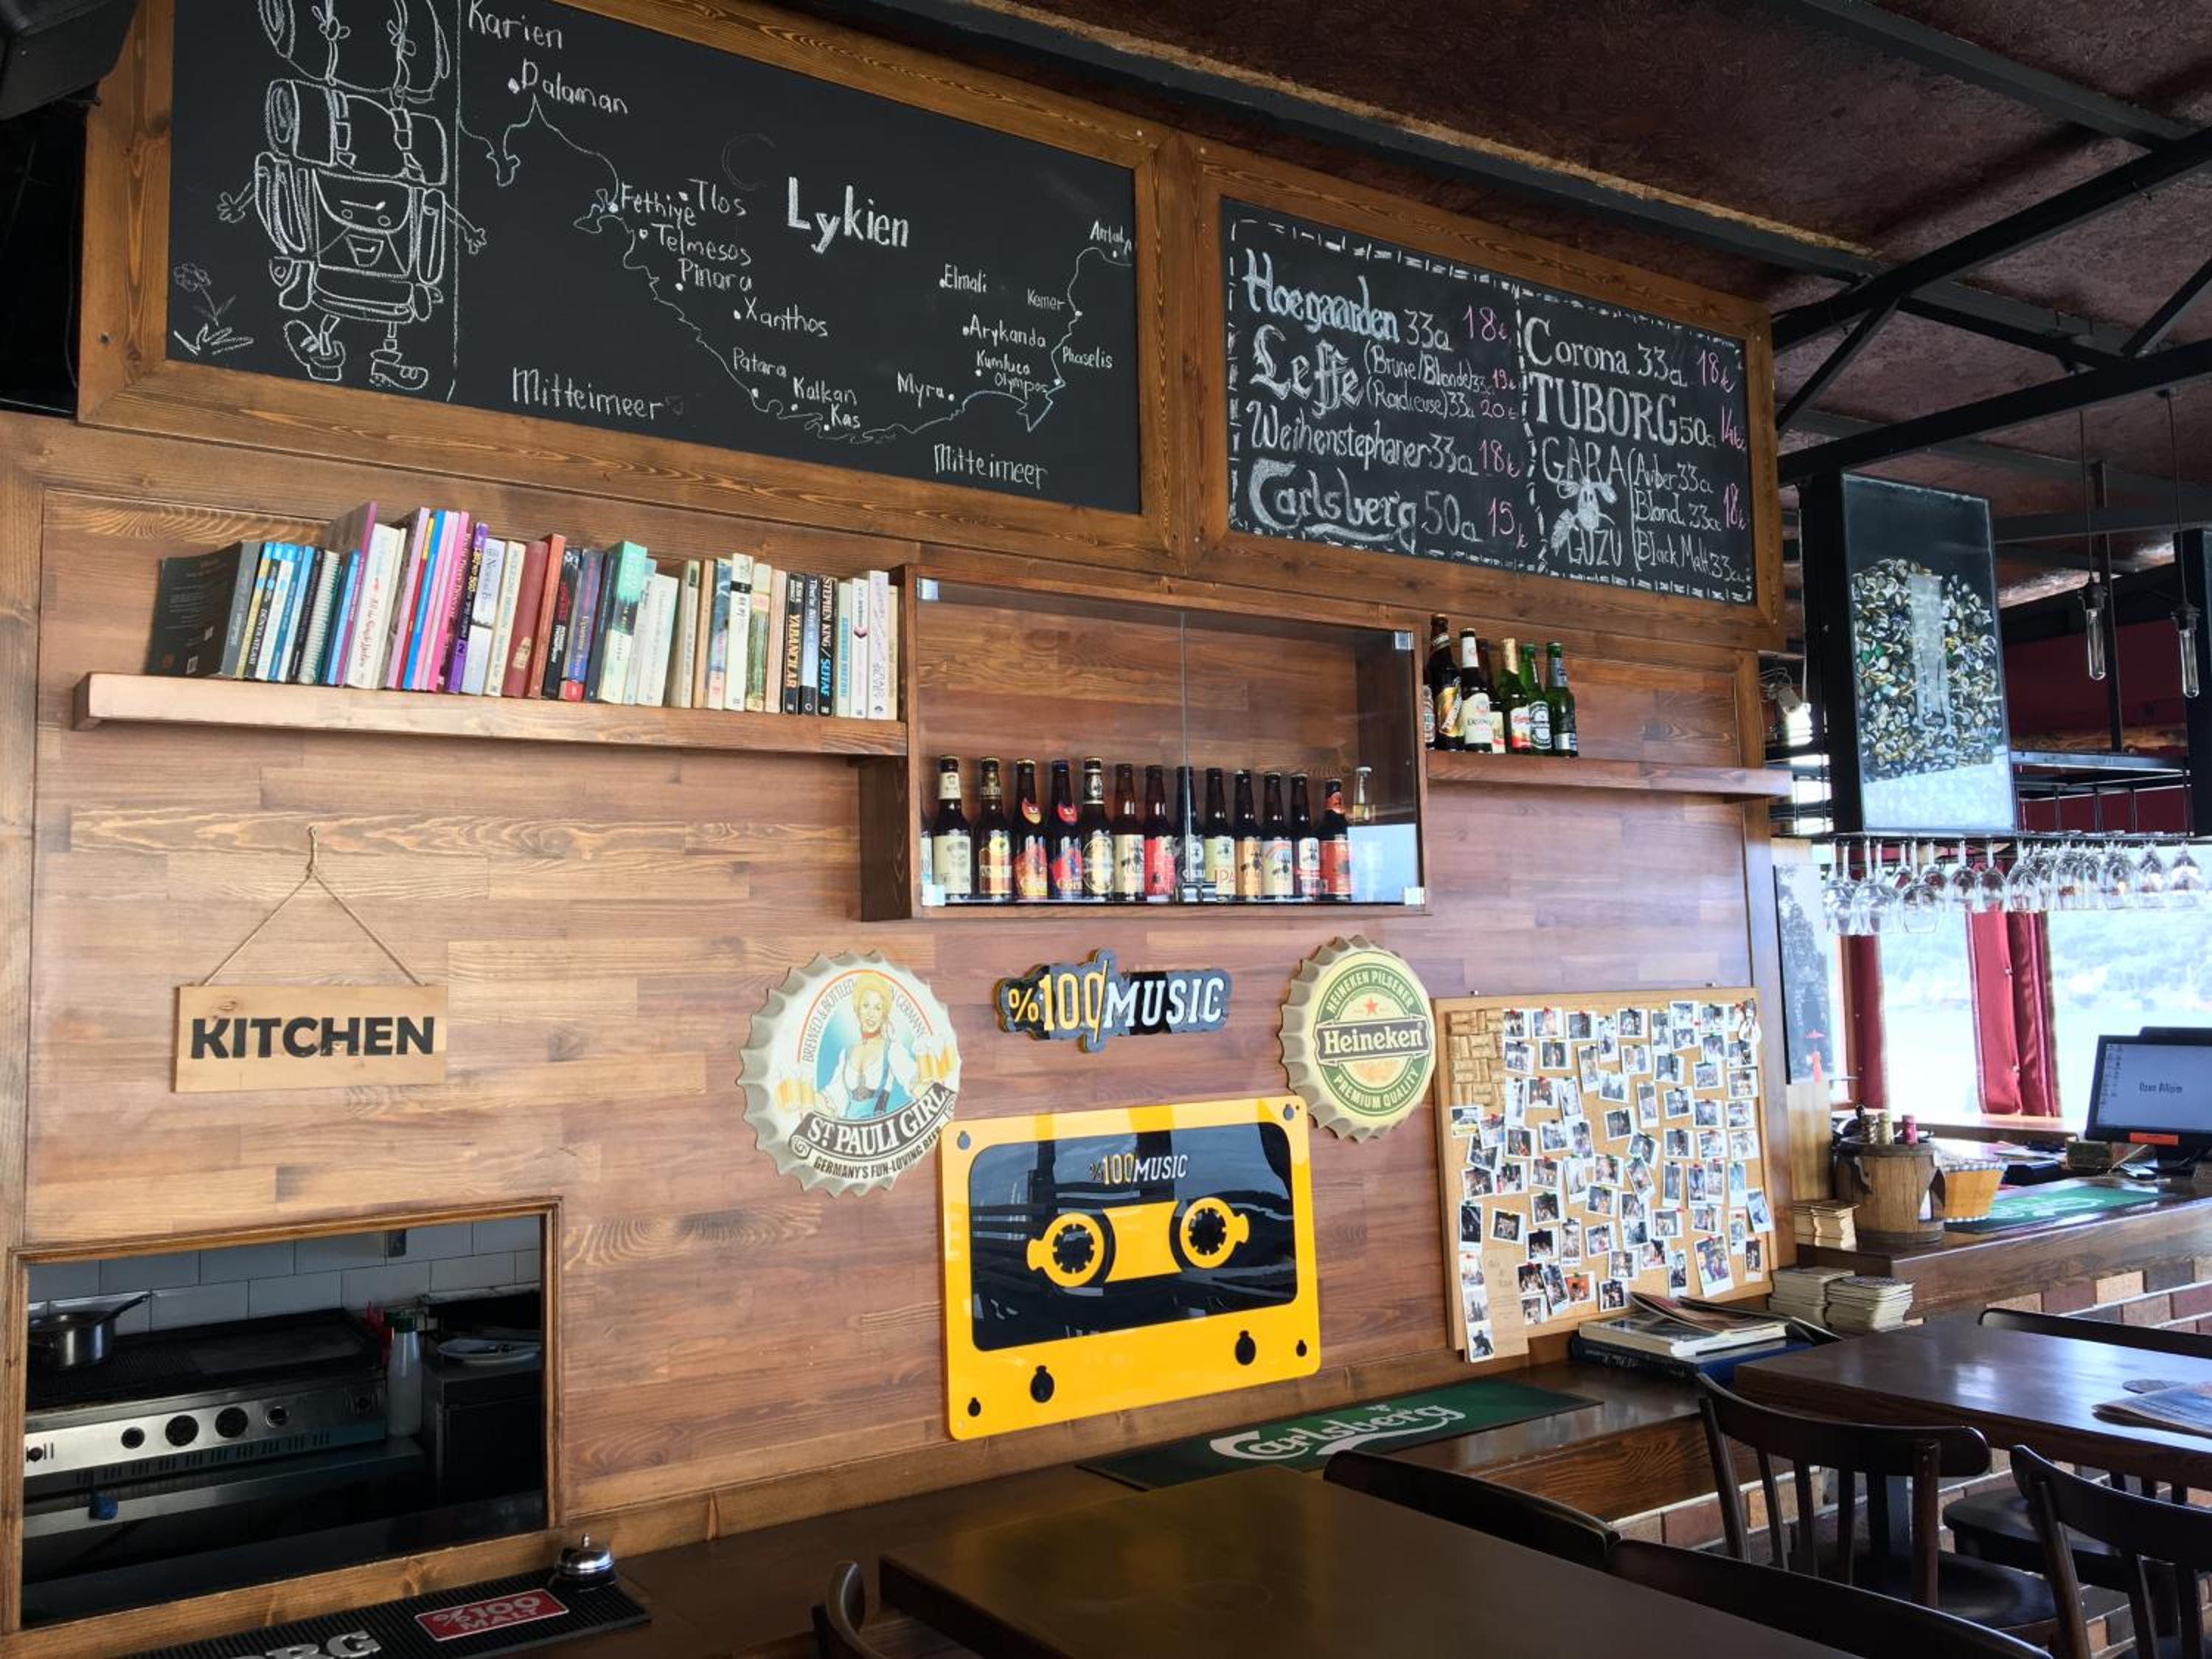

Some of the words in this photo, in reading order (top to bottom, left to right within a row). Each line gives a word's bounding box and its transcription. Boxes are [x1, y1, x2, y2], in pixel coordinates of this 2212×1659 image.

[521, 57, 628, 114] Dalaman
[621, 181, 697, 228] Fethiye
[686, 177, 747, 216] Tlos
[787, 176, 910, 254] Lykien
[650, 223, 752, 266] Telmesos
[678, 257, 753, 292] Pinara
[1242, 247, 1400, 343] Hoegaarden
[744, 296, 828, 337] Xanthos
[970, 313, 1048, 349] Arykanda
[732, 347, 787, 379] Patara
[1062, 345, 1113, 369] Phaselis
[1523, 316, 1630, 375] Corona
[793, 376, 858, 405] Kalkan
[897, 372, 945, 408] Myra
[1250, 323, 1366, 420] Leffe
[1528, 371, 1678, 446] TUBORG
[1543, 437, 1627, 487] GARA
[1248, 457, 1418, 554] Carlsberg
[1568, 528, 1621, 566] GUZU
[821, 577, 833, 622] STEPHEN
[786, 613, 801, 688] YABANCILAR
[821, 623, 832, 647] KING
[1105, 975, 1226, 1029] MUSIC
[1326, 970, 1370, 1013] HEINEKEN
[1371, 970, 1413, 1008] PILSENER
[190, 1016, 435, 1060] KITCHEN
[802, 1016, 824, 1062] BREWED
[1322, 1026, 1424, 1055] Heineken
[1334, 1076, 1382, 1109] PREMIUM
[1382, 1069, 1420, 1107] QUALITY
[833, 1118, 900, 1155] PAULI
[899, 1084, 947, 1140] GIRL
[813, 1155, 869, 1180] GERMANY'S
[870, 1144, 923, 1178] FUN-LOVING
[1133, 1154, 1189, 1183] MUSIC
[1208, 1403, 1466, 1458] Carlsberg
